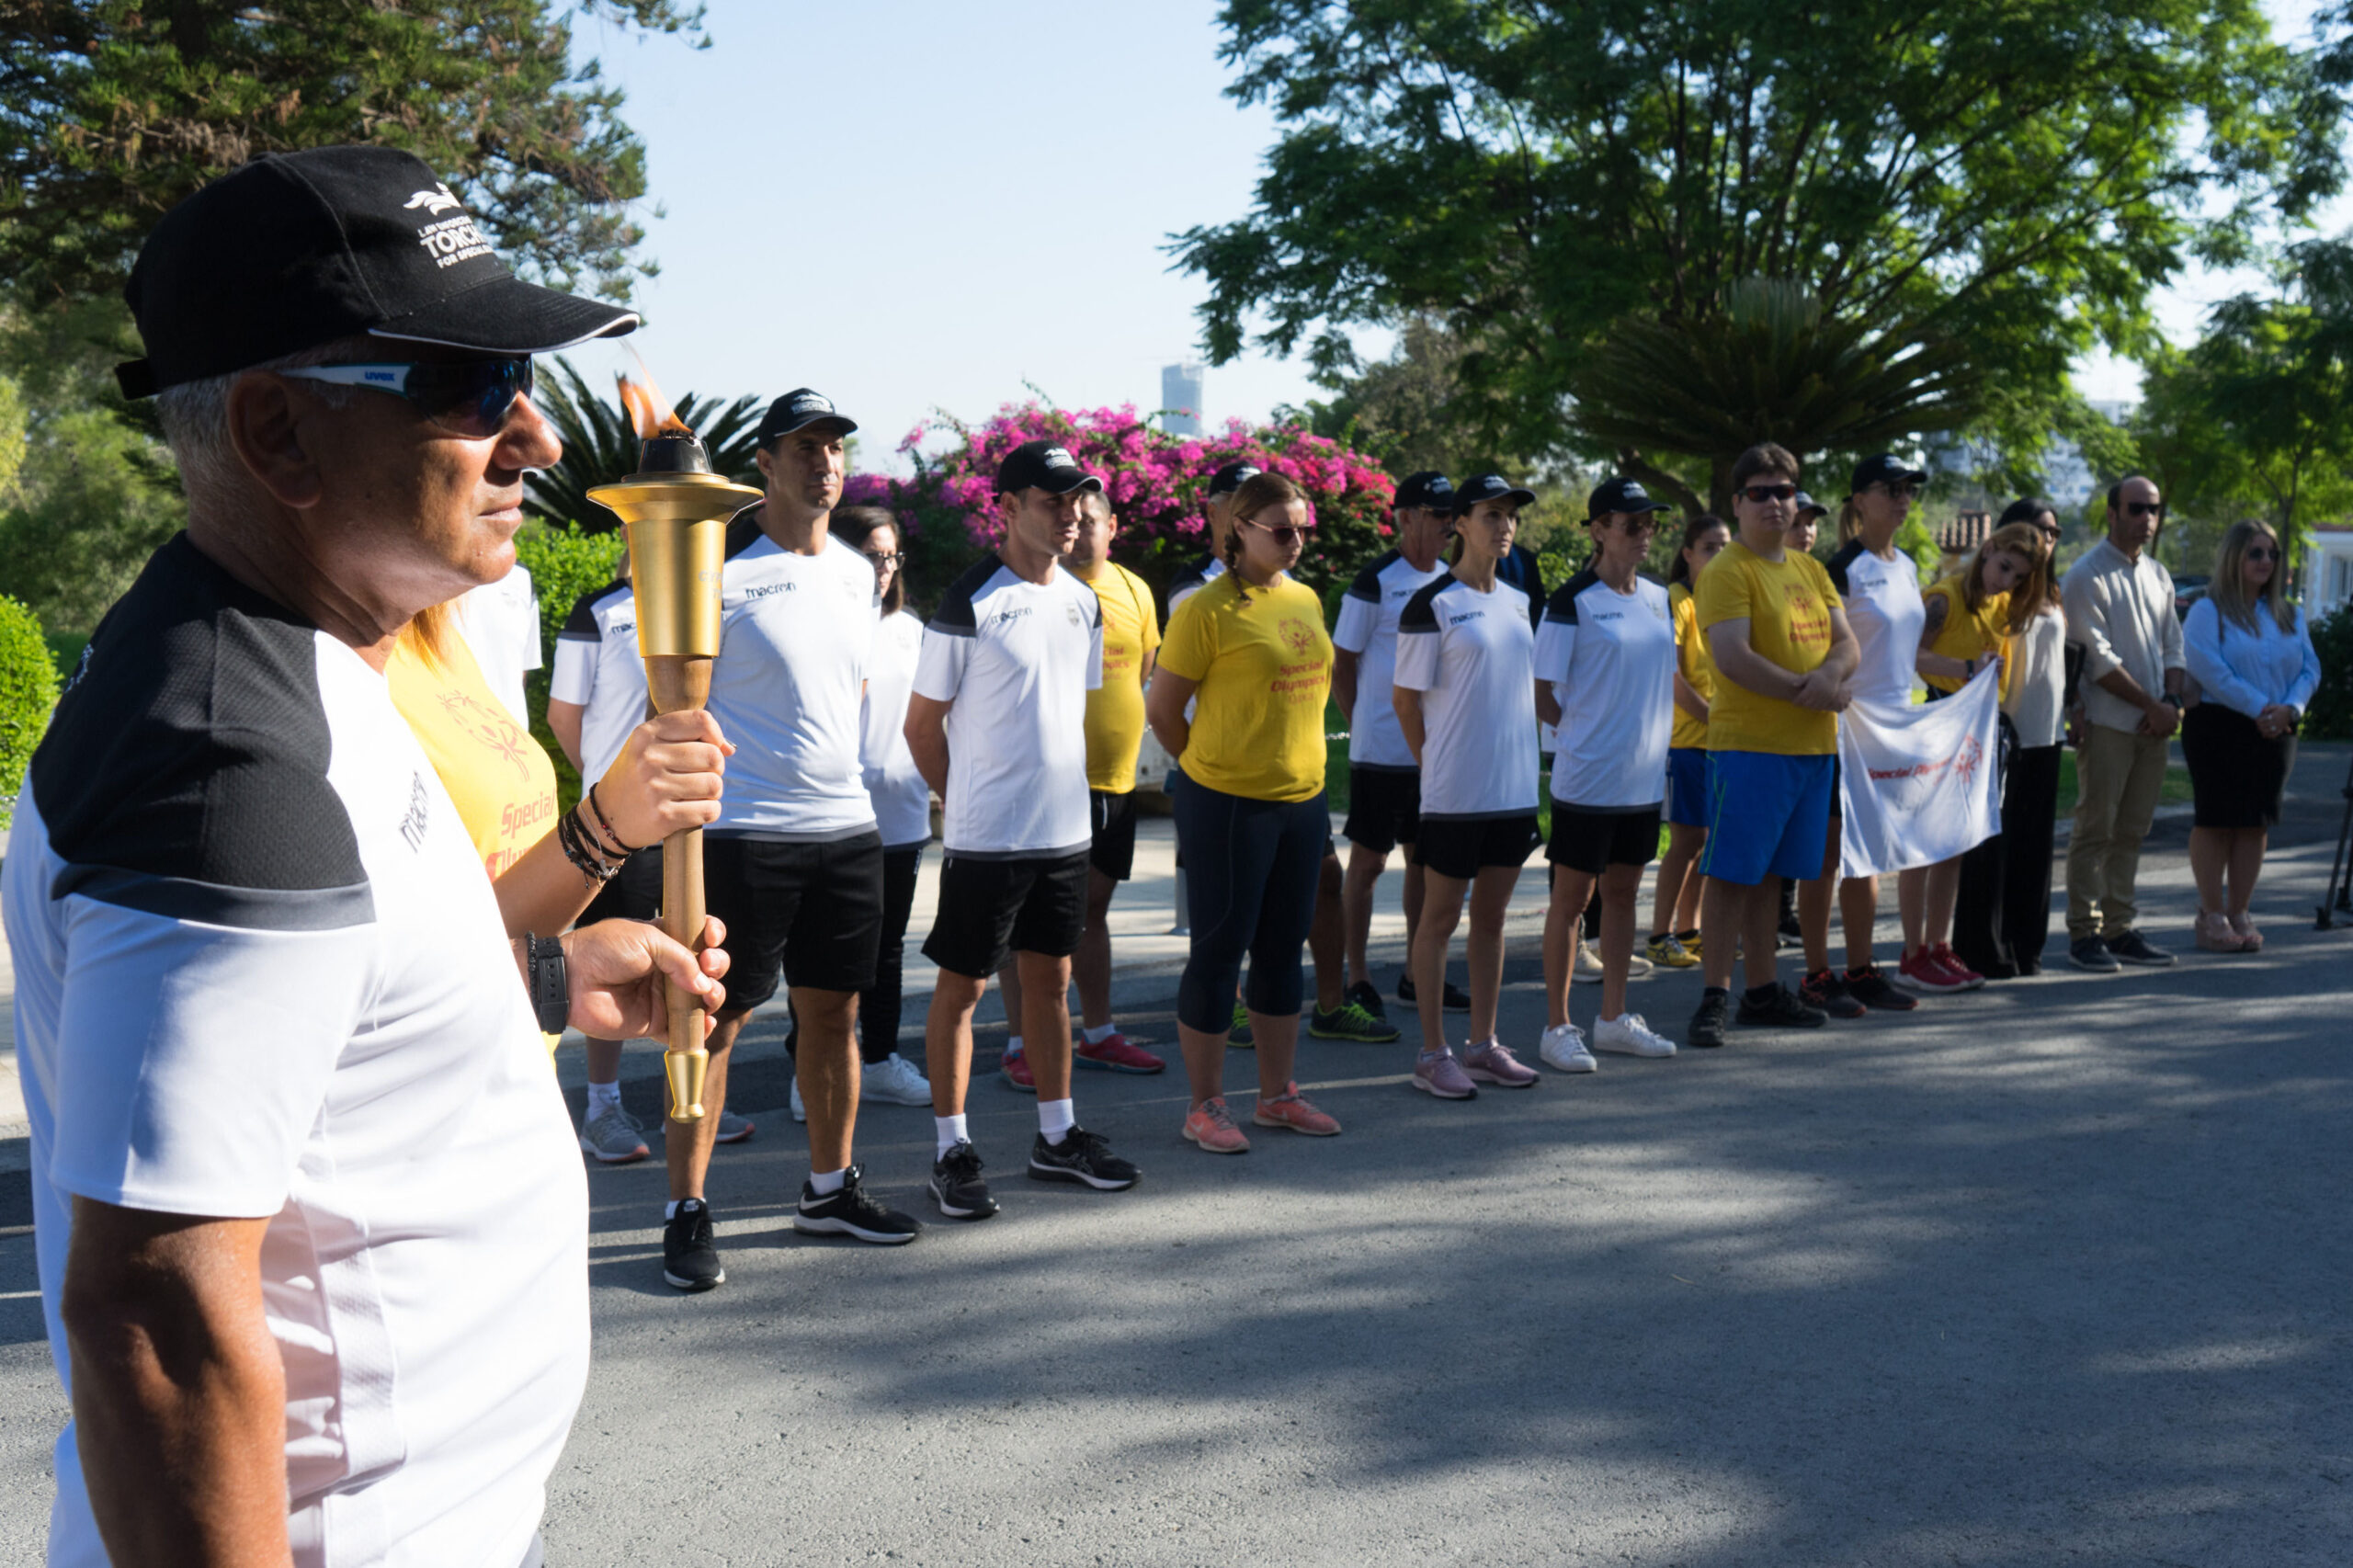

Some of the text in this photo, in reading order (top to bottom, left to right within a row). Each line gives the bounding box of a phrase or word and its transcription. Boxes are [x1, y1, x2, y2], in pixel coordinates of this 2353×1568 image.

[420, 224, 487, 258] TORCH
[745, 582, 797, 598] macron
[1279, 659, 1324, 678] Special
[501, 787, 556, 839] Special
